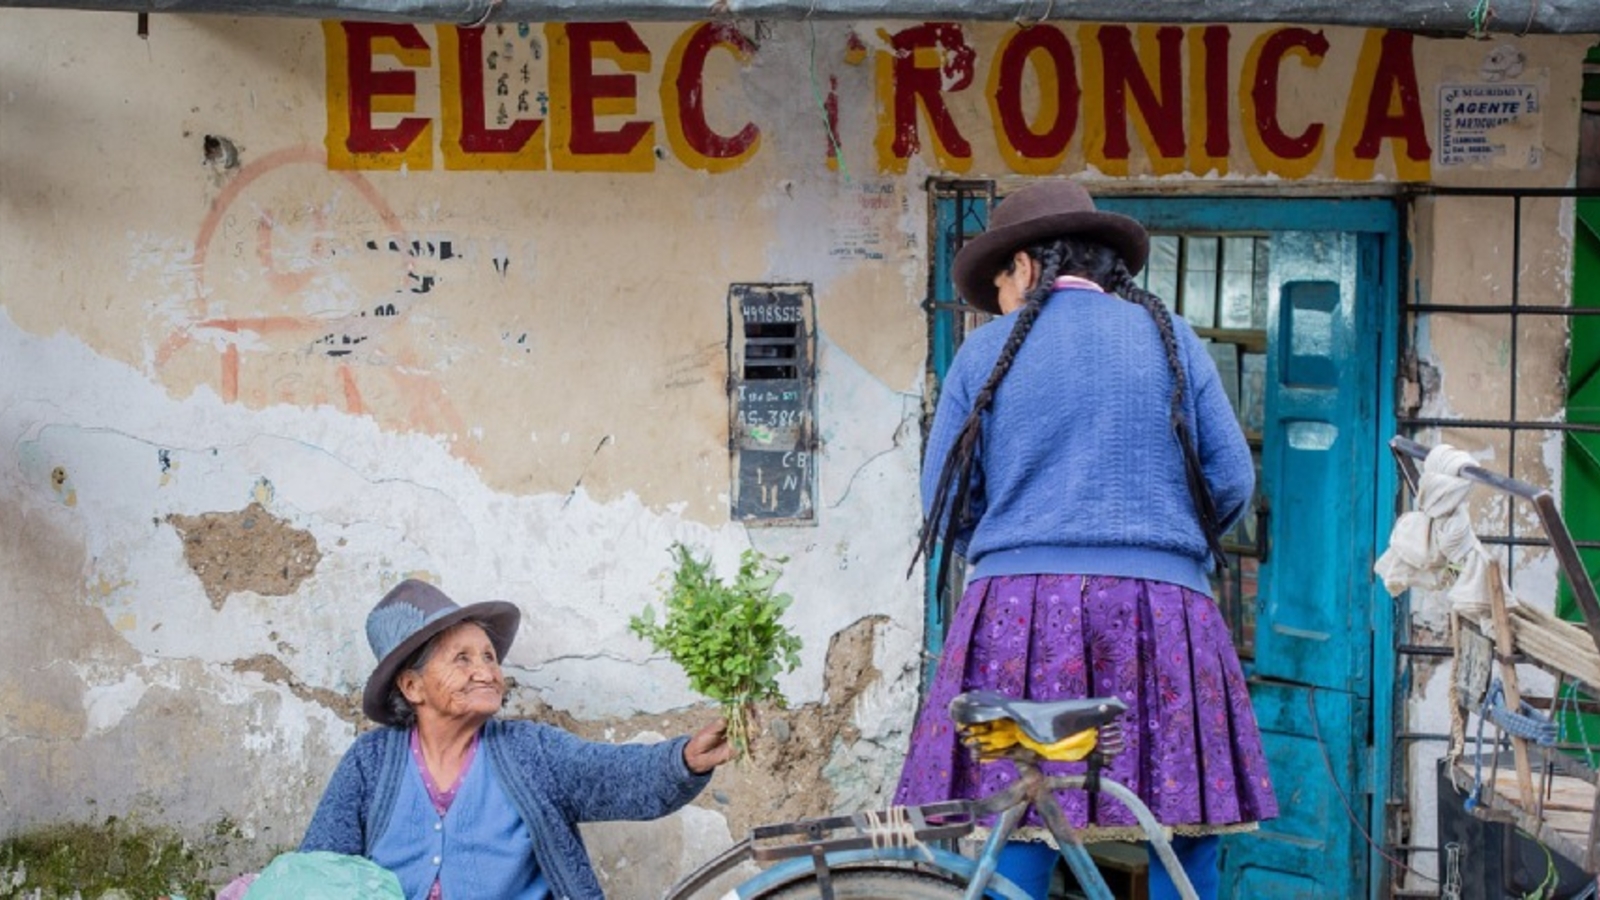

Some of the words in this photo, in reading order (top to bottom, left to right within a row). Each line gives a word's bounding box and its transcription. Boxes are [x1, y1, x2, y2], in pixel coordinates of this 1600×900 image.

[323, 21, 1431, 181] ELECRONICA
[1445, 89, 1460, 103] DE
[1462, 87, 1516, 97] SEGURIDAD
[1454, 102, 1521, 114] AGENTE
